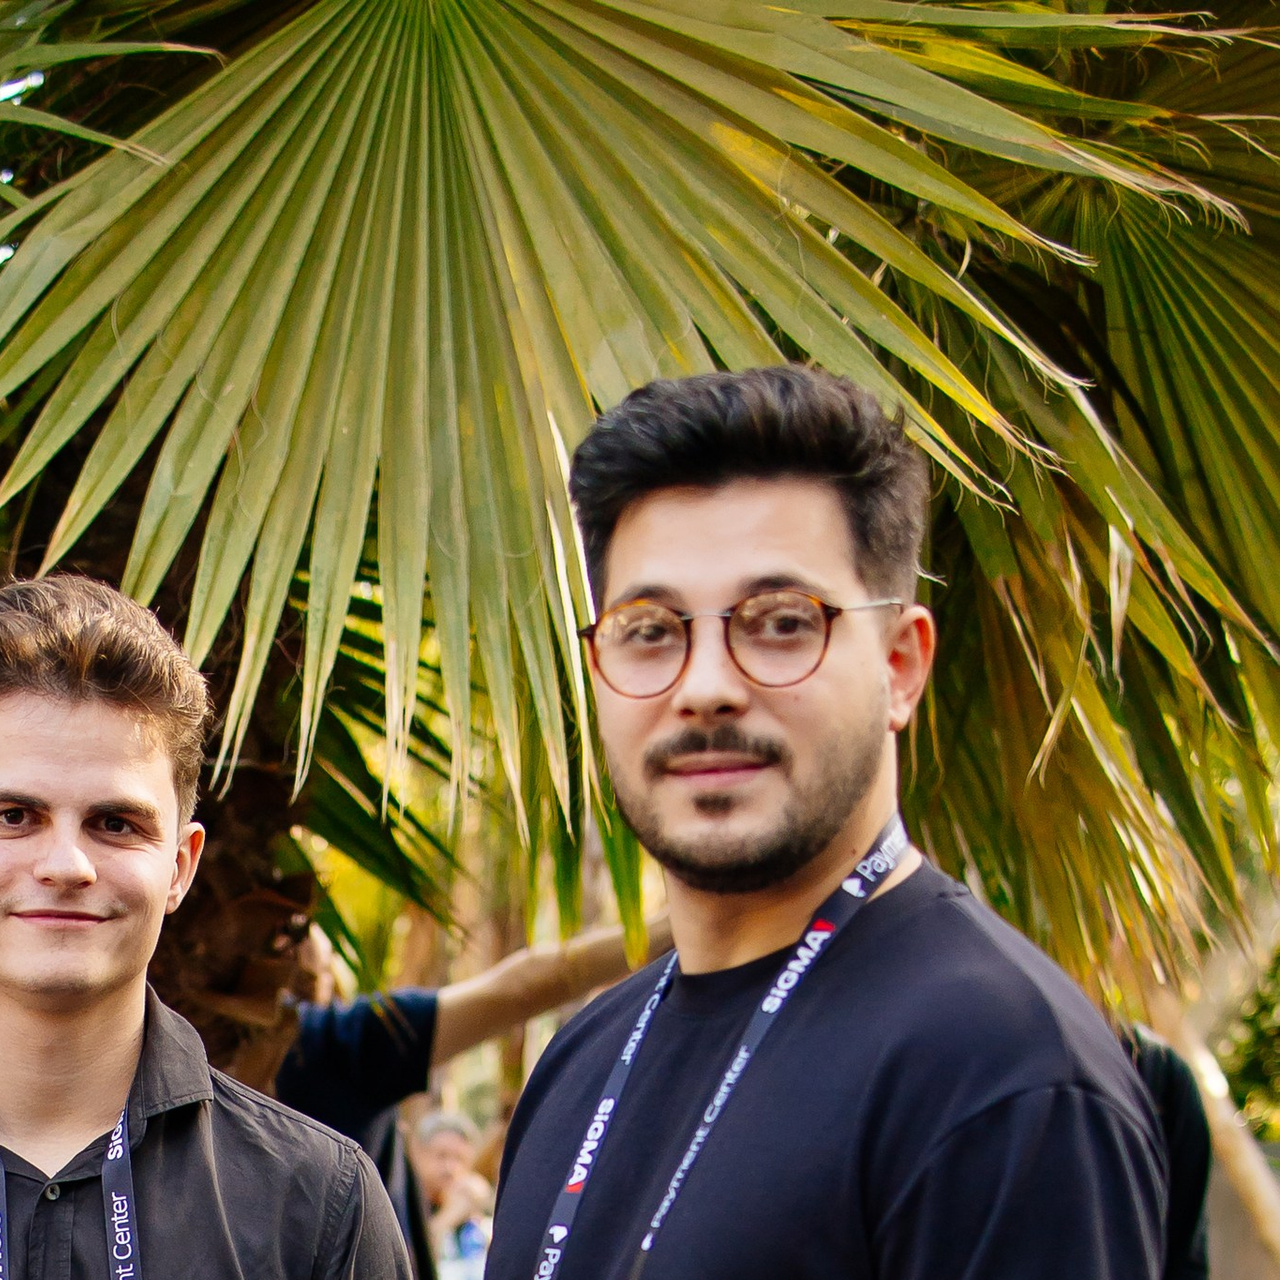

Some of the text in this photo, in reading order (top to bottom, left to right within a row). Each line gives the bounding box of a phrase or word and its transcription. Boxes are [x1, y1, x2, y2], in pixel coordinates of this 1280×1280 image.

[620, 993, 661, 1067] Center
[703, 1044, 750, 1123] Center
[106, 1110, 125, 1160] SiG
[110, 1191, 133, 1260] Center
